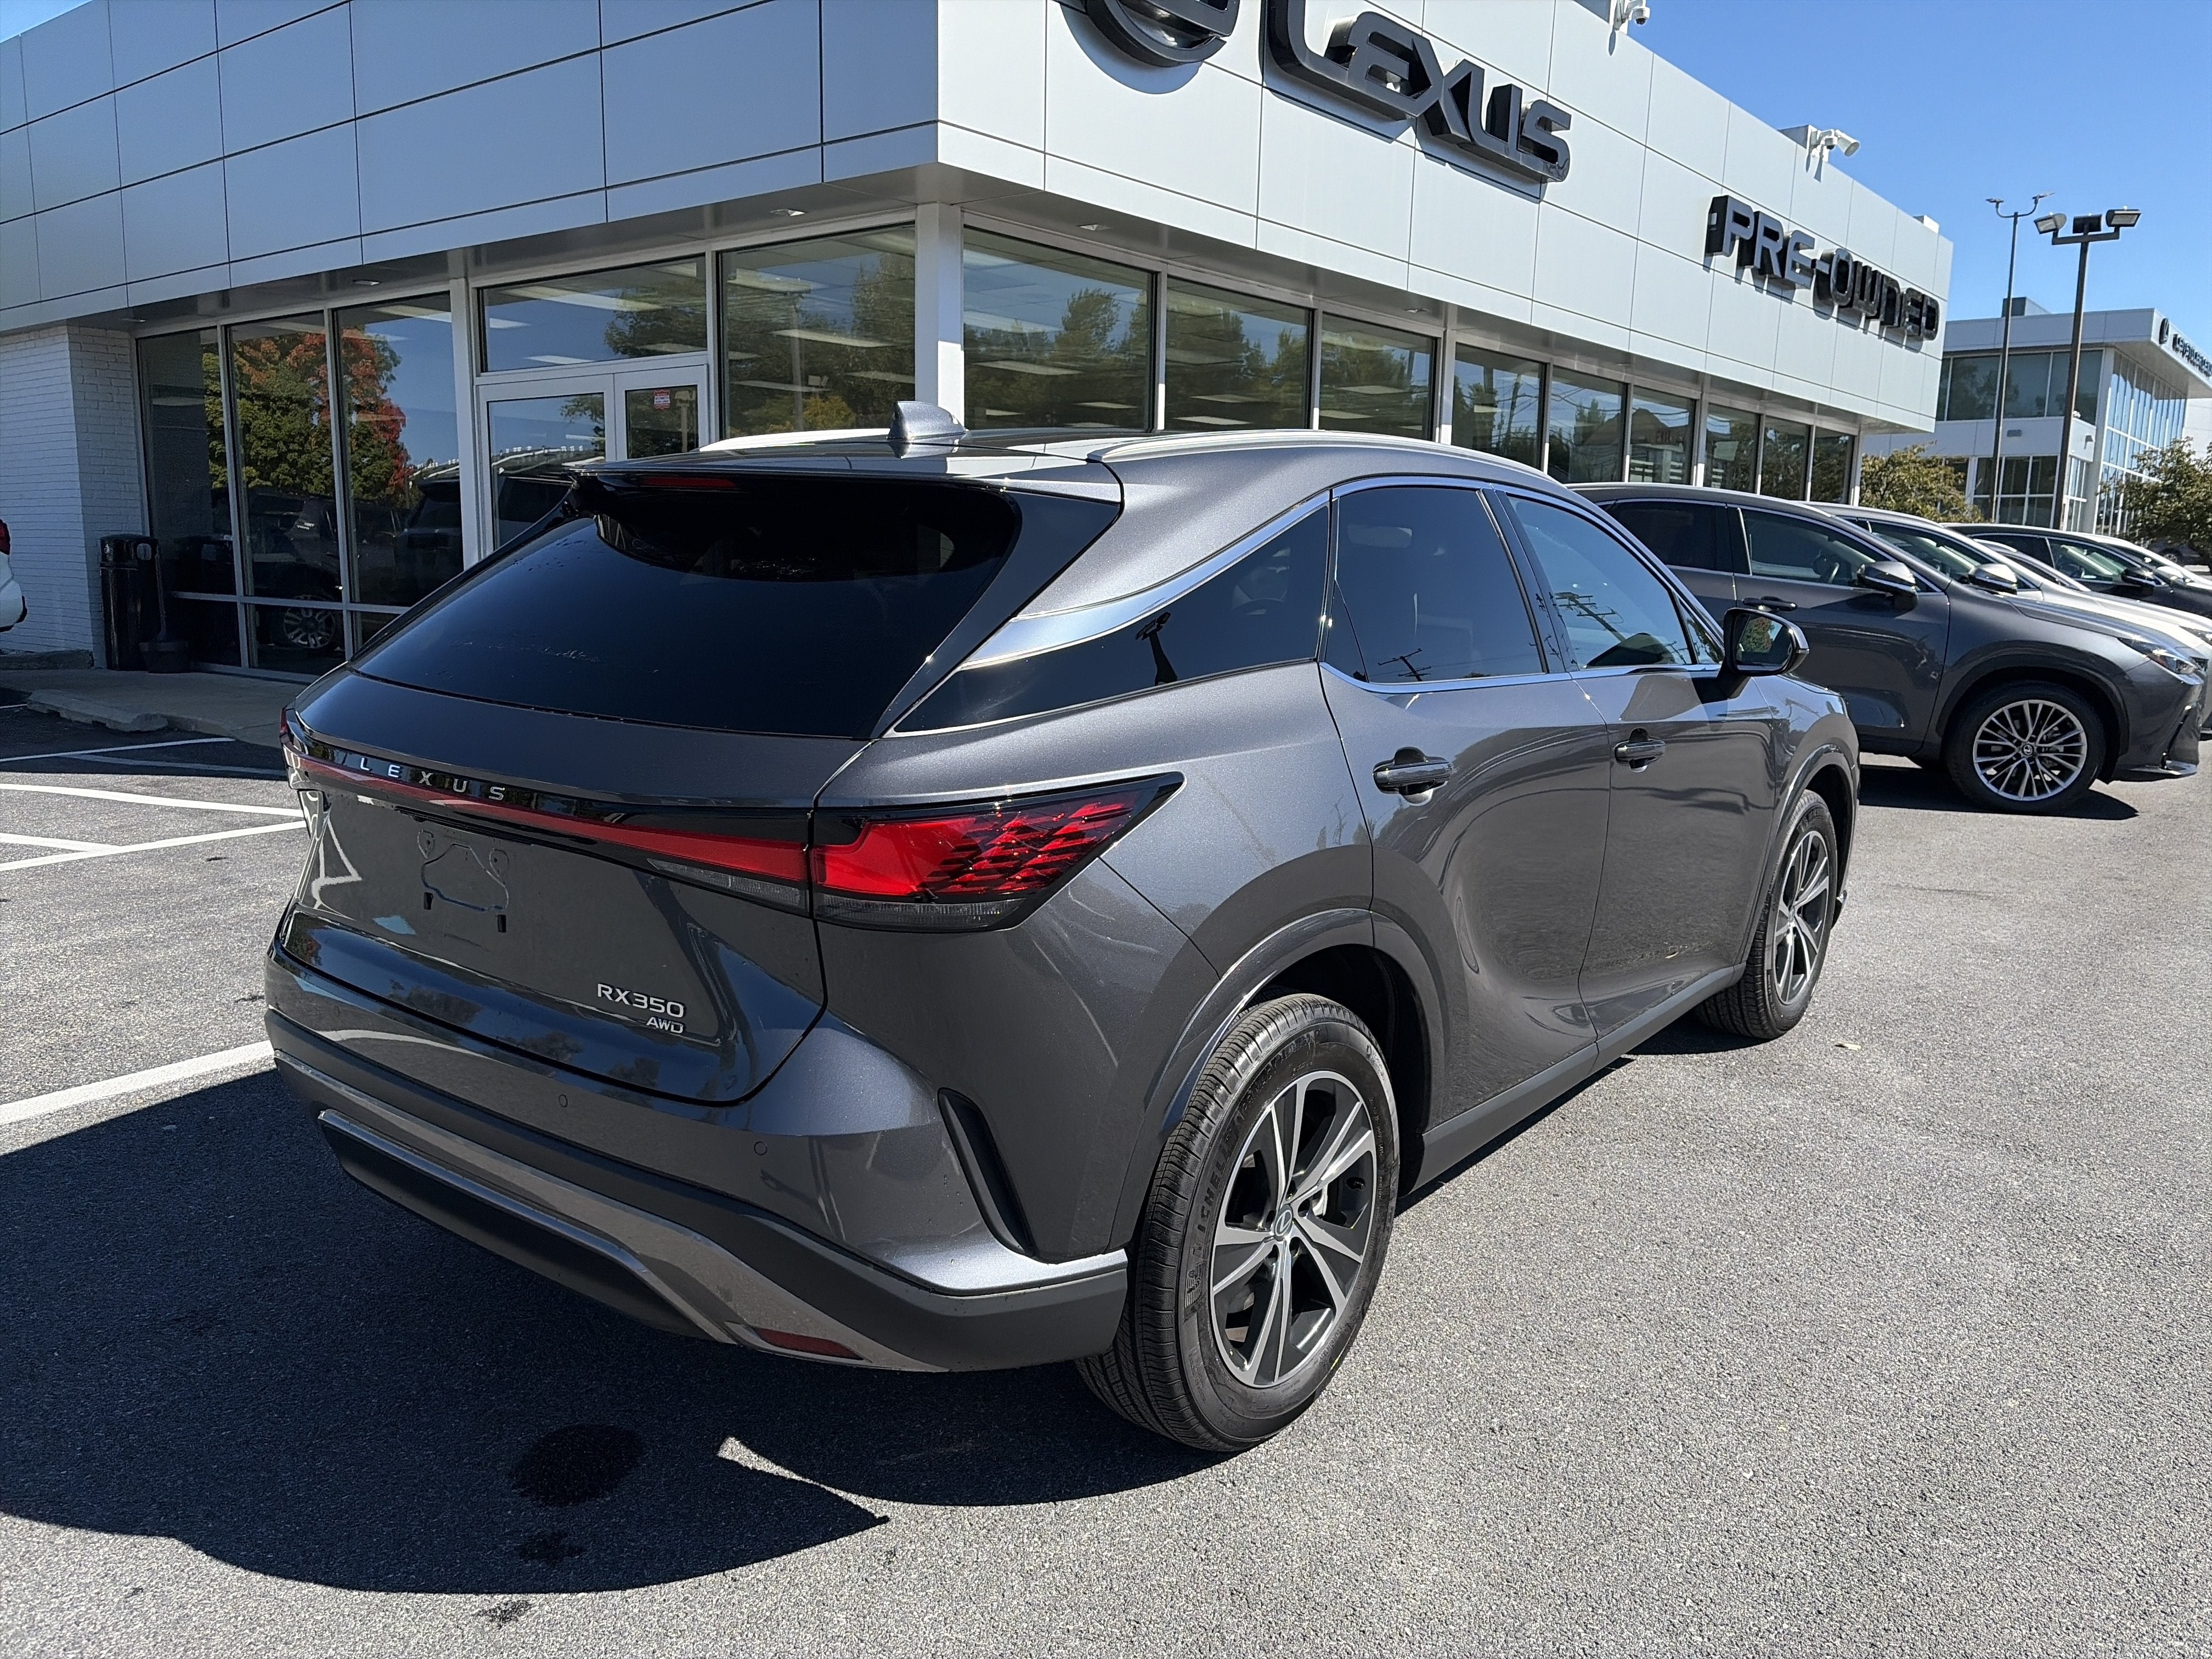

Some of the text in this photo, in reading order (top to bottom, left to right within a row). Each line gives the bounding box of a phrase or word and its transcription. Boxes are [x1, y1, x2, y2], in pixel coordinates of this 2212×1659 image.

[1261, 0, 1571, 182] LEXUS
[1705, 195, 1940, 341] PRE-OWNED
[360, 757, 505, 800] LEXUS
[597, 983, 684, 1018] RX350
[646, 1017, 684, 1034] AWD
[1192, 1125, 1238, 1258] ICHELI
